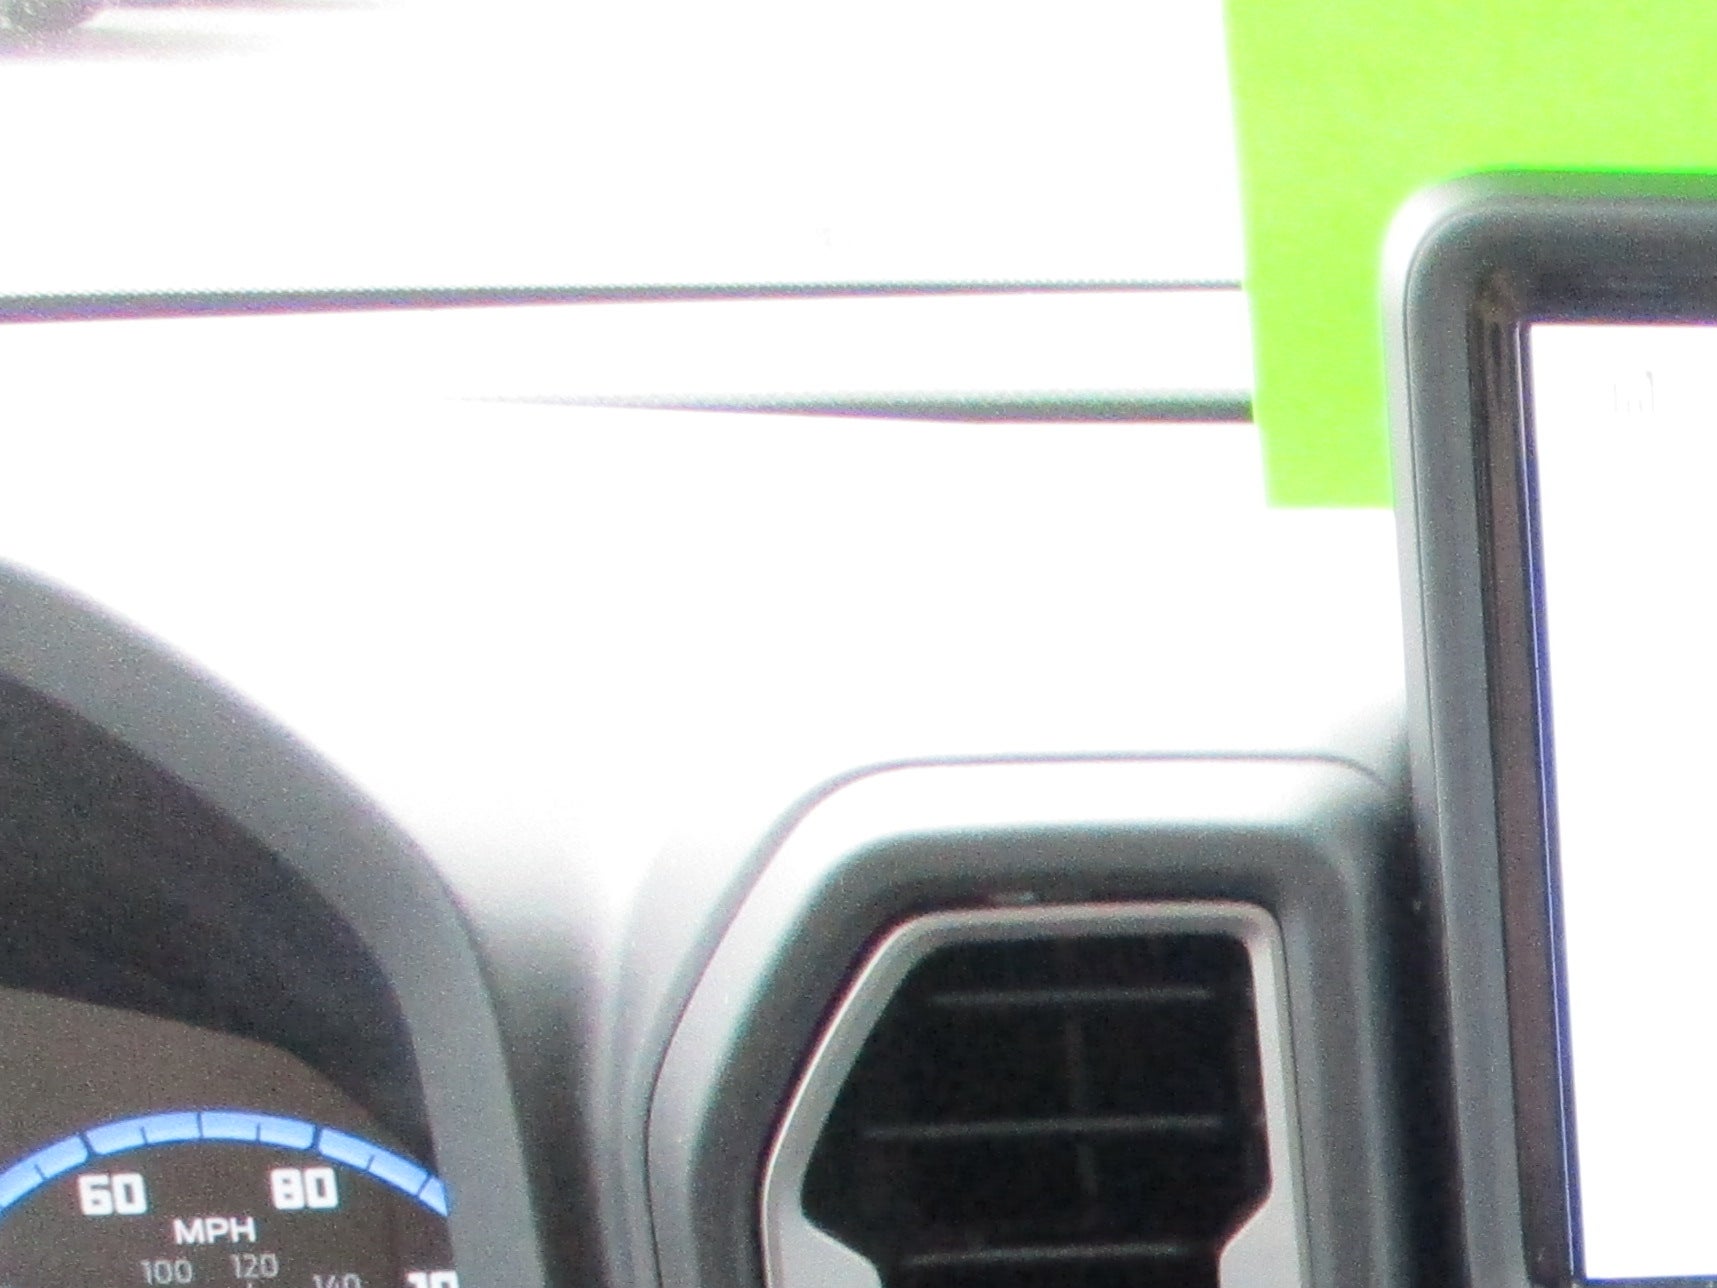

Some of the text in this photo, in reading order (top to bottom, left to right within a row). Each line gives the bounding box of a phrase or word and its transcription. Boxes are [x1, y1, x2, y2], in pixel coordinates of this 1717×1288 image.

[78, 1172, 148, 1216] 60
[270, 1167, 338, 1210] 80
[173, 1216, 257, 1246] MPH
[140, 1258, 193, 1286] 100
[231, 1252, 280, 1280] 120
